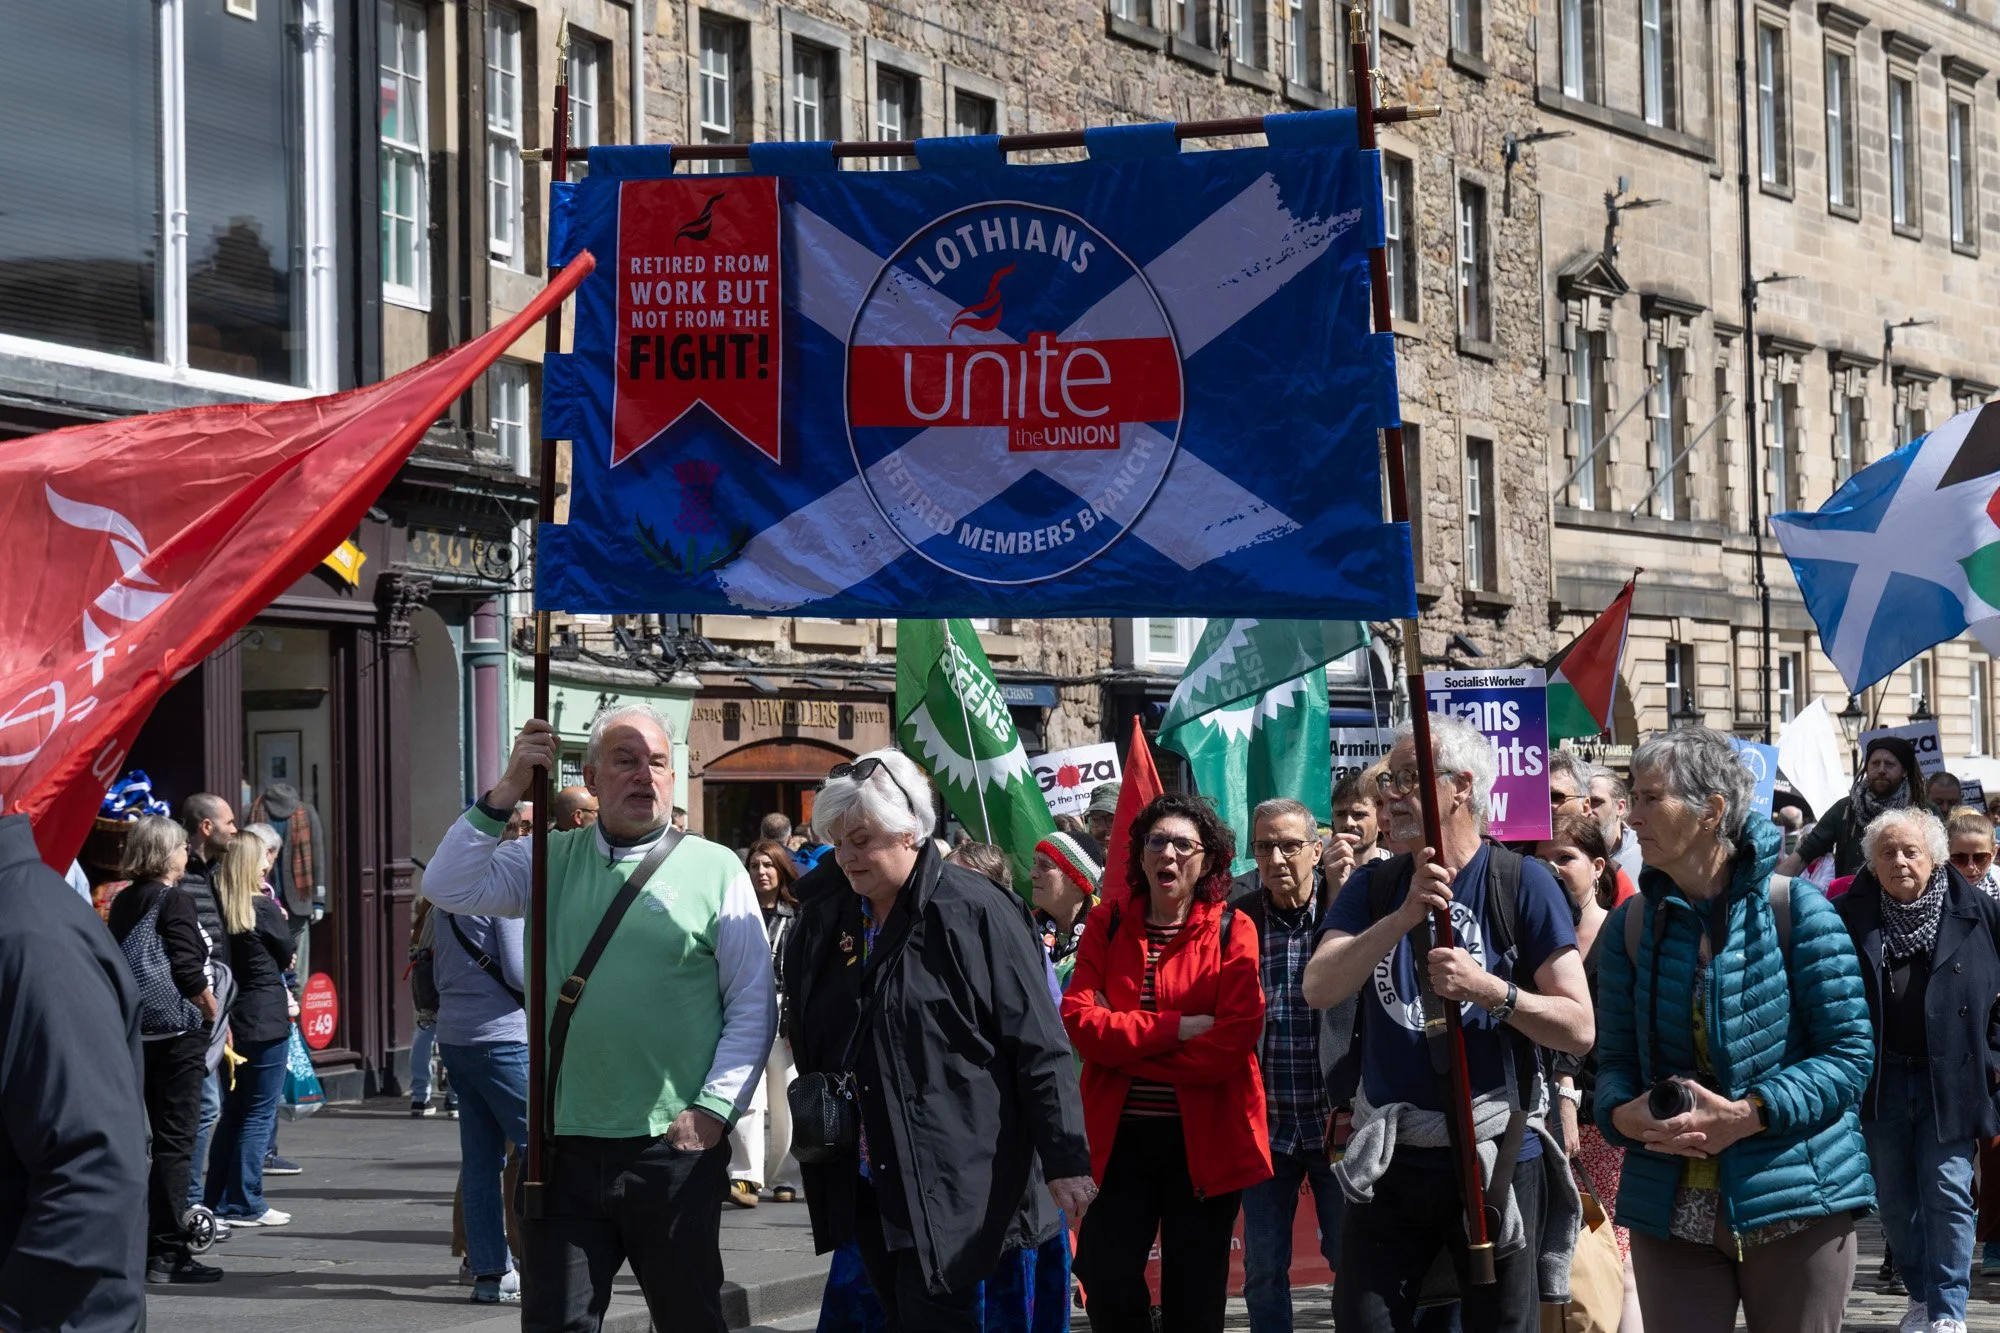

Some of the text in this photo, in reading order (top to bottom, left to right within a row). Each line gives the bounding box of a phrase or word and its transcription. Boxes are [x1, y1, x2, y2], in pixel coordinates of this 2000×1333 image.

[631, 254, 769, 275] RETIRED FROM
[915, 216, 1096, 286] LOTHIANS
[630, 279, 769, 306] WORK BUT
[631, 309, 770, 329] NOT FROM THE
[629, 333, 769, 381] FIGHT!
[903, 335, 1112, 421] unite
[882, 436, 1155, 555] RETIRED MEMBERS BRANCH
[1000, 686, 1034, 700] RCHANTS
[750, 699, 839, 729] JEWELLERS
[1430, 691, 1522, 732] Trans
[1058, 795, 1073, 806] the
[308, 1013, 333, 1036] £49
